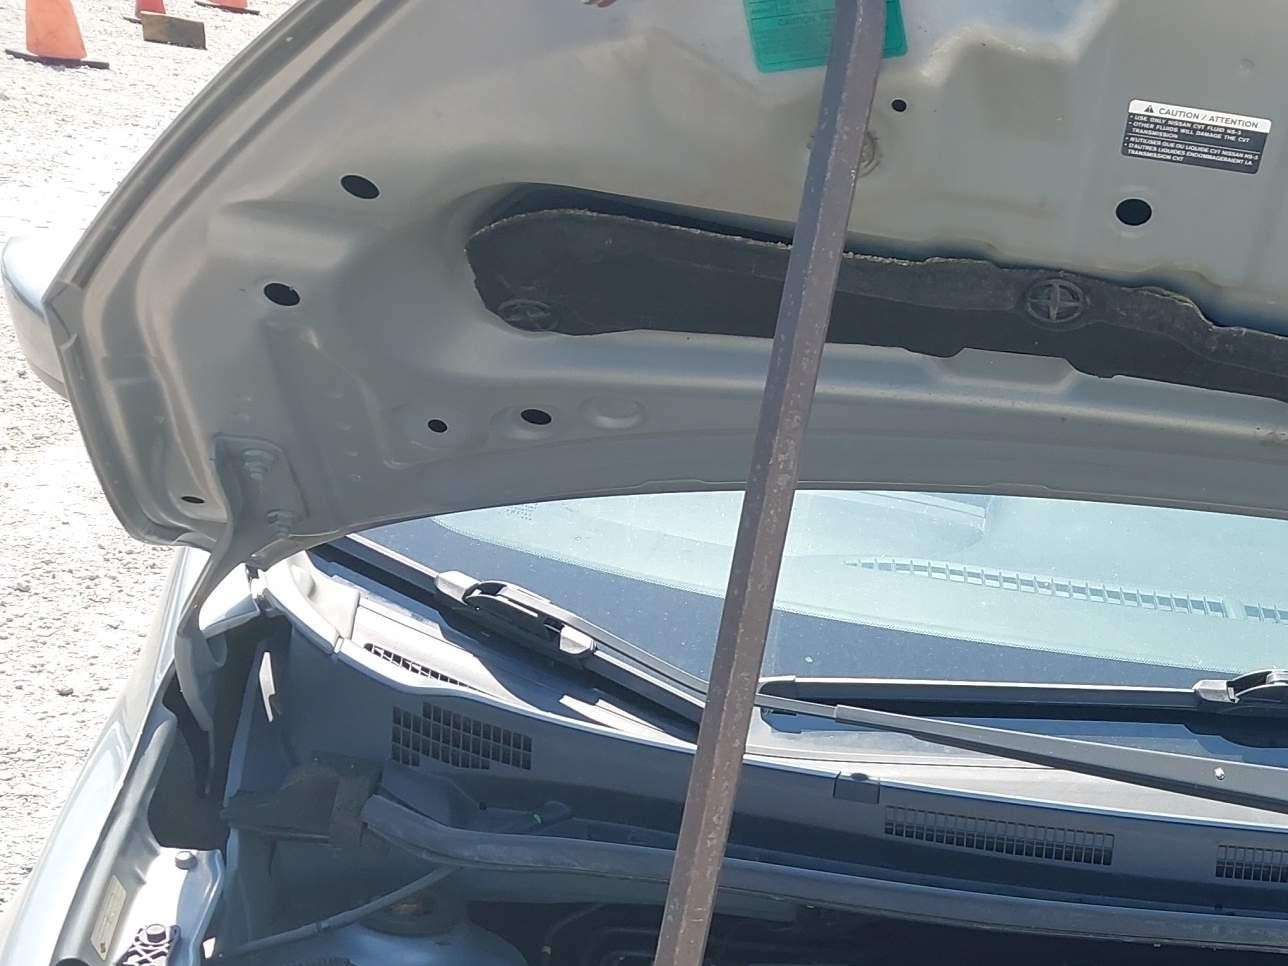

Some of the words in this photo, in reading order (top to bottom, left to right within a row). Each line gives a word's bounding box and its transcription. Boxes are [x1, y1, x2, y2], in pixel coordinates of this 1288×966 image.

[1159, 108, 1200, 119] CAUTION
[1209, 115, 1259, 128] ATTENTION
[1132, 128, 1178, 138] TRANSMISSION
[1196, 131, 1222, 139] DAMAGE
[1128, 149, 1172, 159] TRANSMISSION
[1221, 150, 1244, 158] NISSAN
